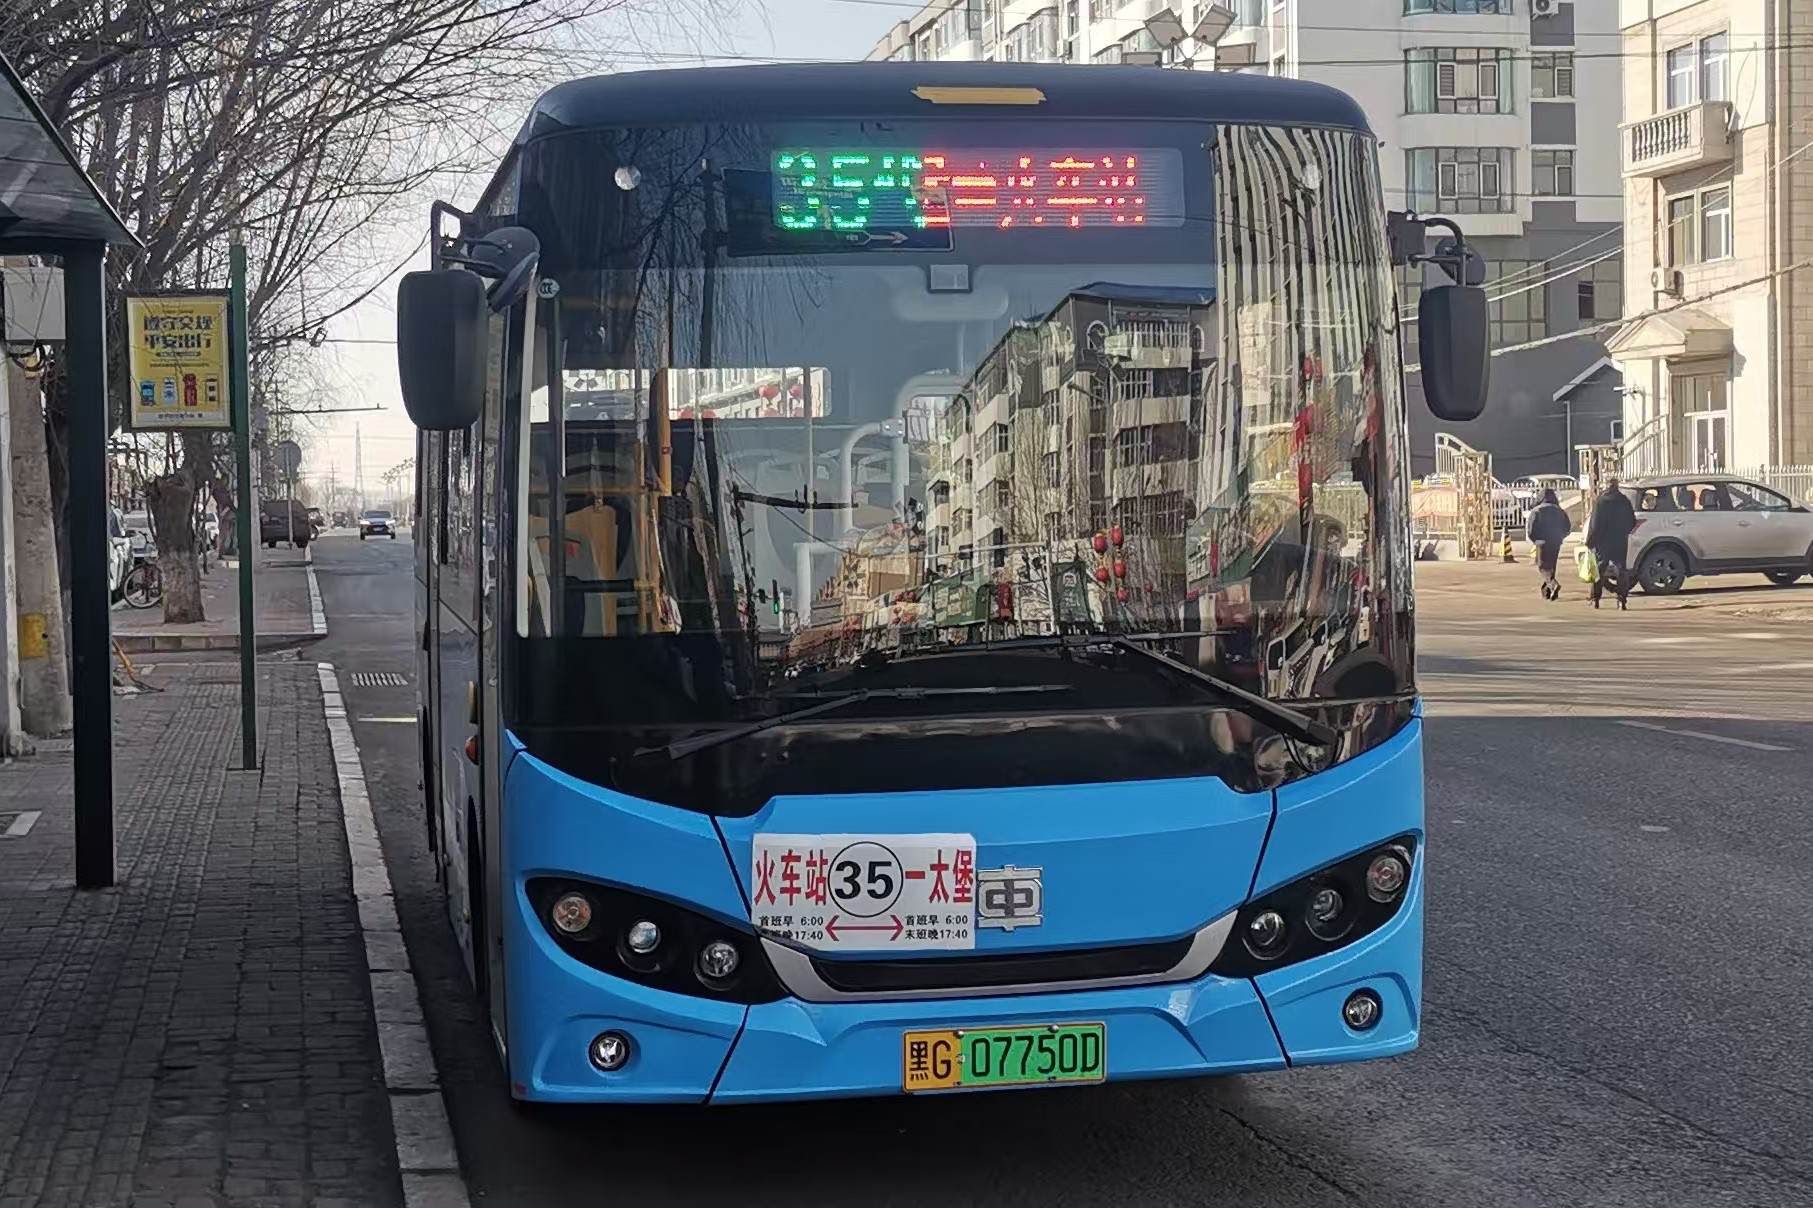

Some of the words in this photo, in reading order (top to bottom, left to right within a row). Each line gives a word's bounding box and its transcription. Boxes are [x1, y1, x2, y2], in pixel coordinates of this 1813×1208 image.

[753, 849, 829, 906] 火车站
[834, 860, 895, 900] 35
